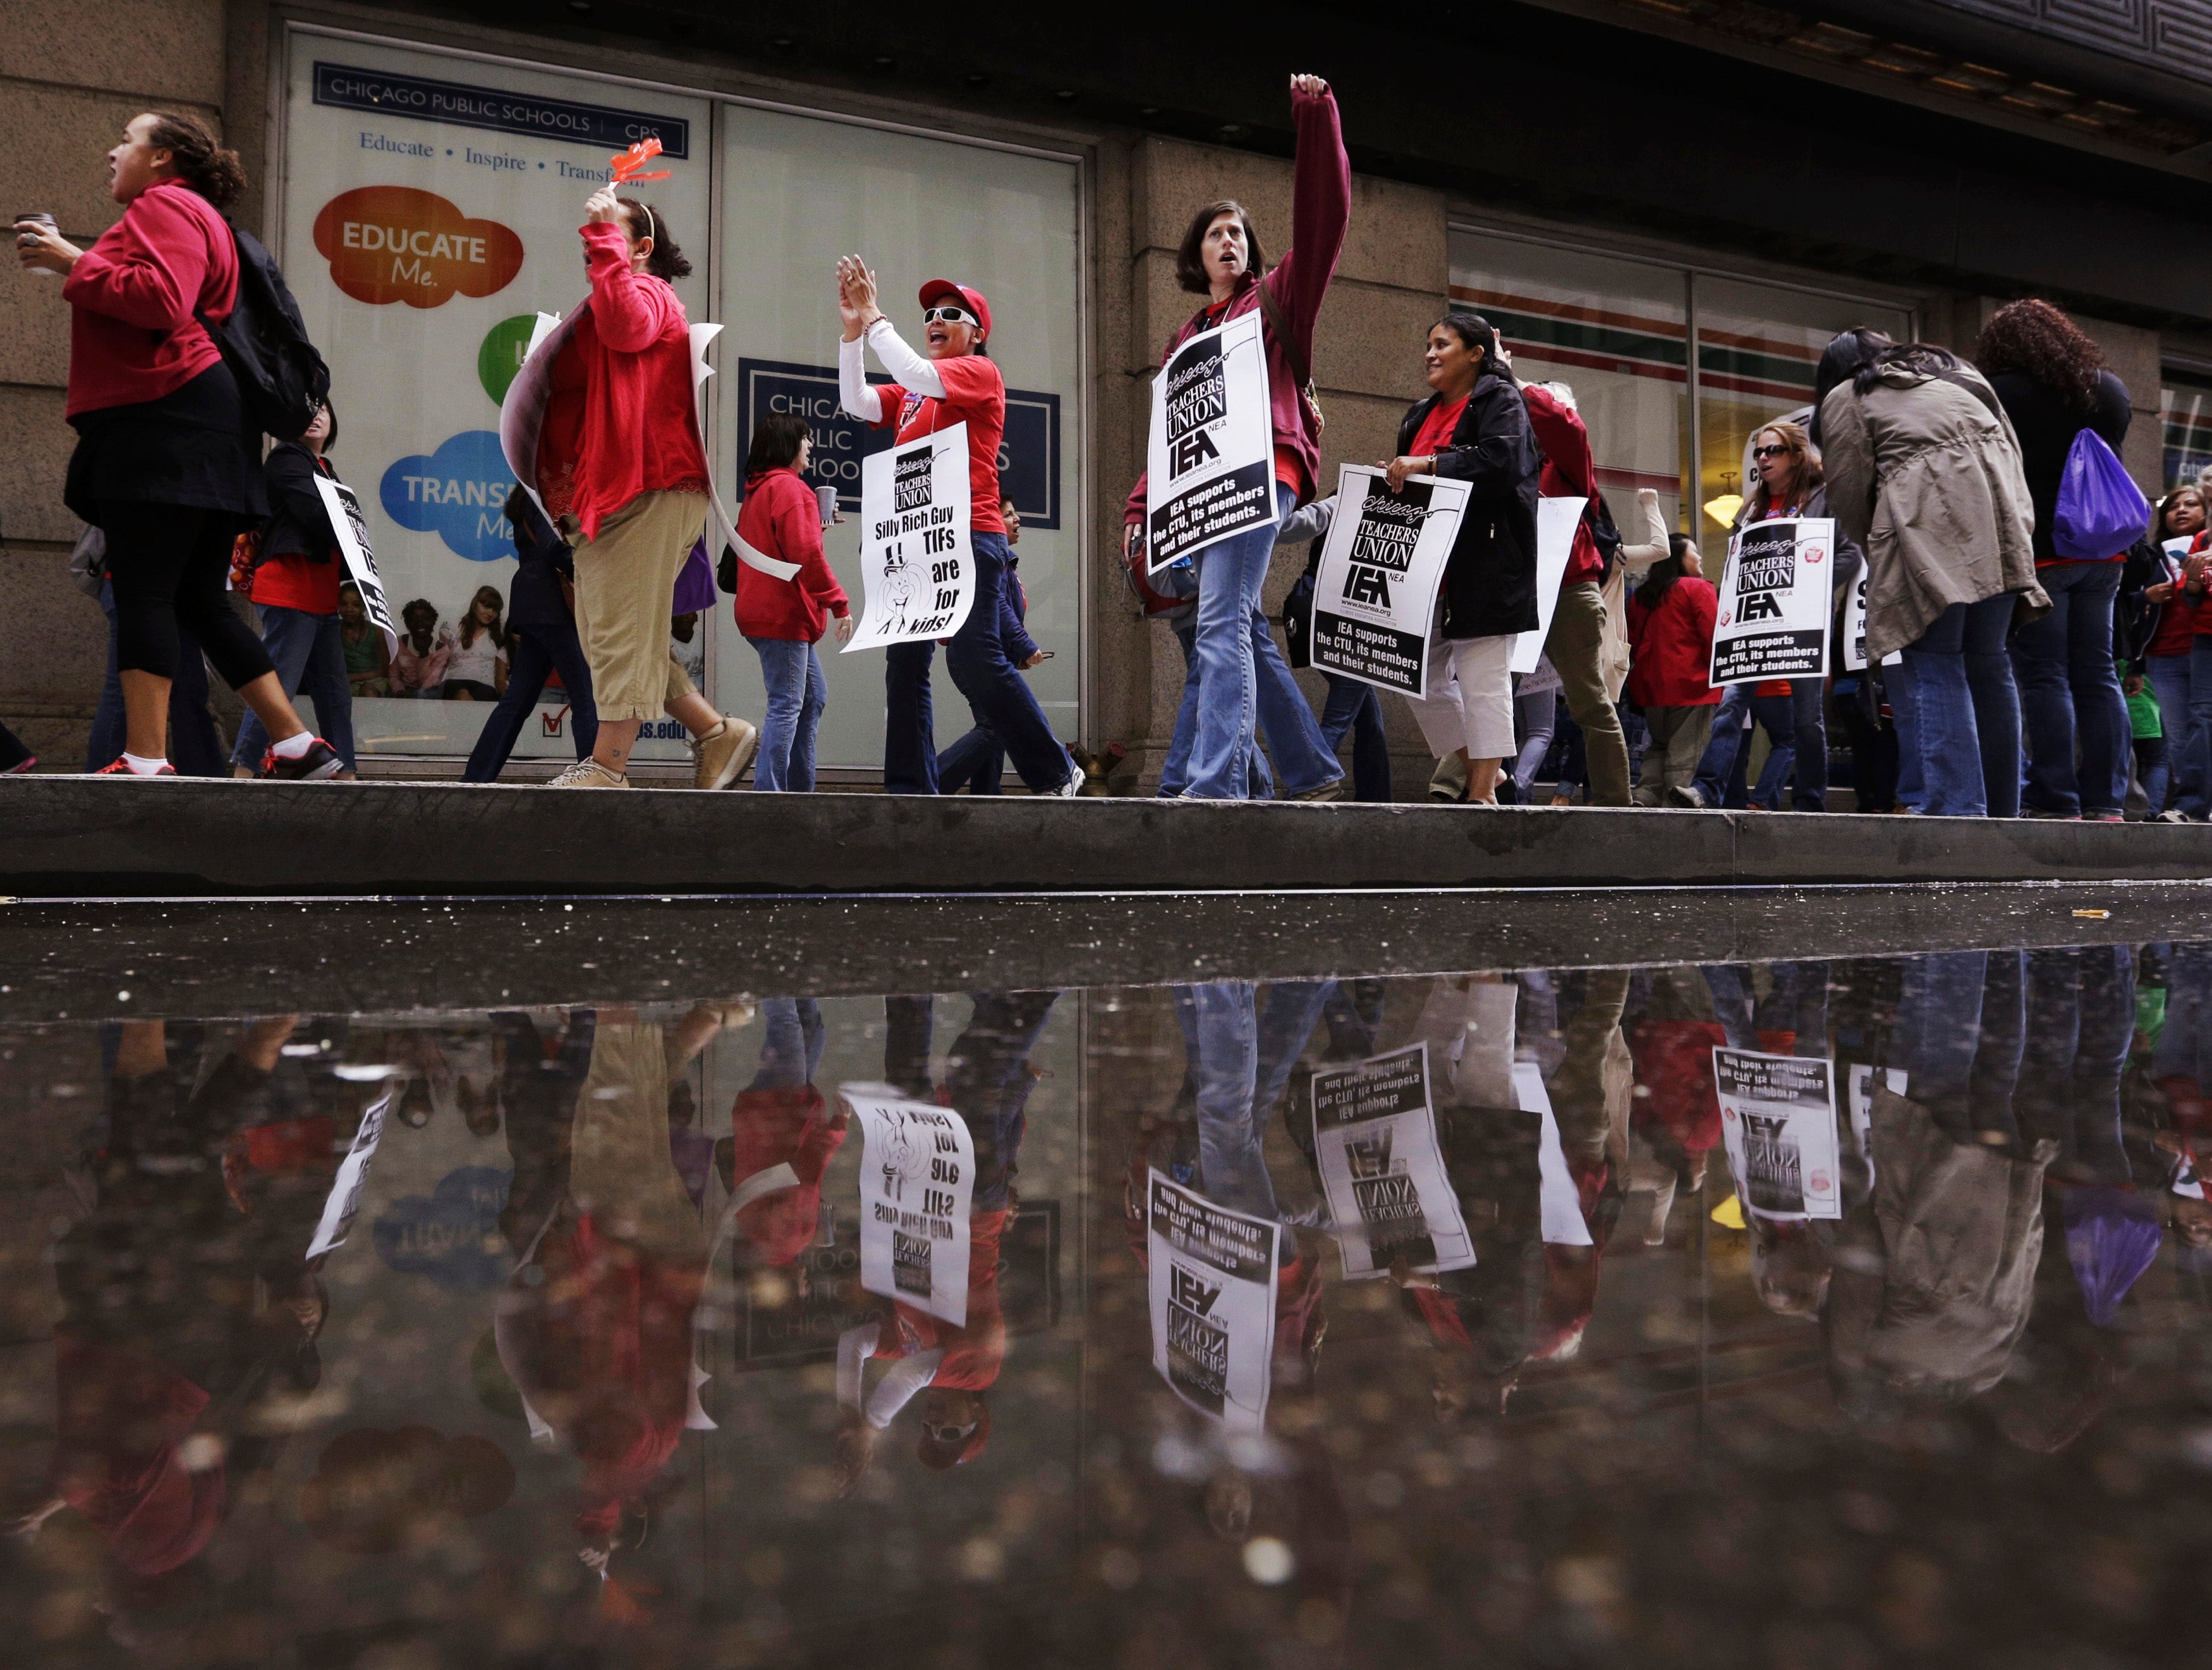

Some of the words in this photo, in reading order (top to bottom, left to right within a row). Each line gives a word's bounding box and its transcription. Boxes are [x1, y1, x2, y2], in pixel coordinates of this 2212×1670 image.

[331, 78, 425, 106] CHICAGO
[432, 94, 497, 117] PUBLIC
[502, 105, 590, 131] SCHOOLS
[625, 124, 660, 140] CPS
[360, 131, 434, 157] Educate
[465, 146, 526, 171] Inspire
[556, 160, 645, 188] Transfm
[343, 221, 486, 264] EDUCATE
[391, 257, 438, 287] Me.
[769, 394, 865, 423] CHICA
[1167, 375, 1224, 419] TEACHERS
[1167, 391, 1224, 440] UNION
[1208, 419, 1227, 433] NEA
[808, 428, 852, 450] BLIC
[1169, 428, 1220, 481] IEA
[402, 475, 518, 509] TRANS
[895, 473, 931, 494] TEACHERS
[896, 485, 931, 510] UNION
[1170, 499, 1185, 517] IEA
[1187, 479, 1236, 508] supports
[875, 519, 899, 540] Silly
[902, 511, 928, 533] Rich
[931, 505, 953, 525] Guy
[1153, 528, 1167, 544] the
[1169, 514, 1189, 535] CTU,
[1191, 508, 1205, 523] its
[1208, 485, 1265, 515] members
[1160, 540, 1176, 556] and
[1177, 526, 1201, 545] their
[1204, 505, 1260, 533] students.
[1359, 519, 1419, 545] TEACHERS
[1354, 535, 1414, 567] UNION
[1739, 555, 1794, 576] TEACHERS
[932, 559, 960, 584] are
[1342, 564, 1391, 608] IEA
[1388, 572, 1404, 583] NEA
[1738, 568, 1794, 593] UNION
[935, 588, 960, 611] for
[1341, 599, 1391, 617] www.ieanea.org
[1735, 592, 1784, 624] IEA
[905, 612, 954, 636] kids!
[1337, 620, 1352, 636] IEA
[1355, 628, 1397, 648] supports
[1316, 631, 1332, 645] the
[1334, 636, 1354, 654] CTU,
[1357, 643, 1369, 656] its
[1371, 648, 1418, 670] members
[1716, 657, 1728, 666] the
[1730, 652, 1748, 663] CTU,
[1751, 650, 1764, 660] its
[1766, 646, 1819, 658] members
[1732, 639, 1746, 651] IEA
[1748, 635, 1795, 648] supports
[1323, 650, 1340, 663] and
[1342, 654, 1365, 670] their
[1367, 662, 1413, 685] students.
[1720, 665, 1735, 677] and
[1737, 663, 1759, 673] their
[1761, 659, 1813, 672] students.
[635, 719, 686, 742] s.edu
